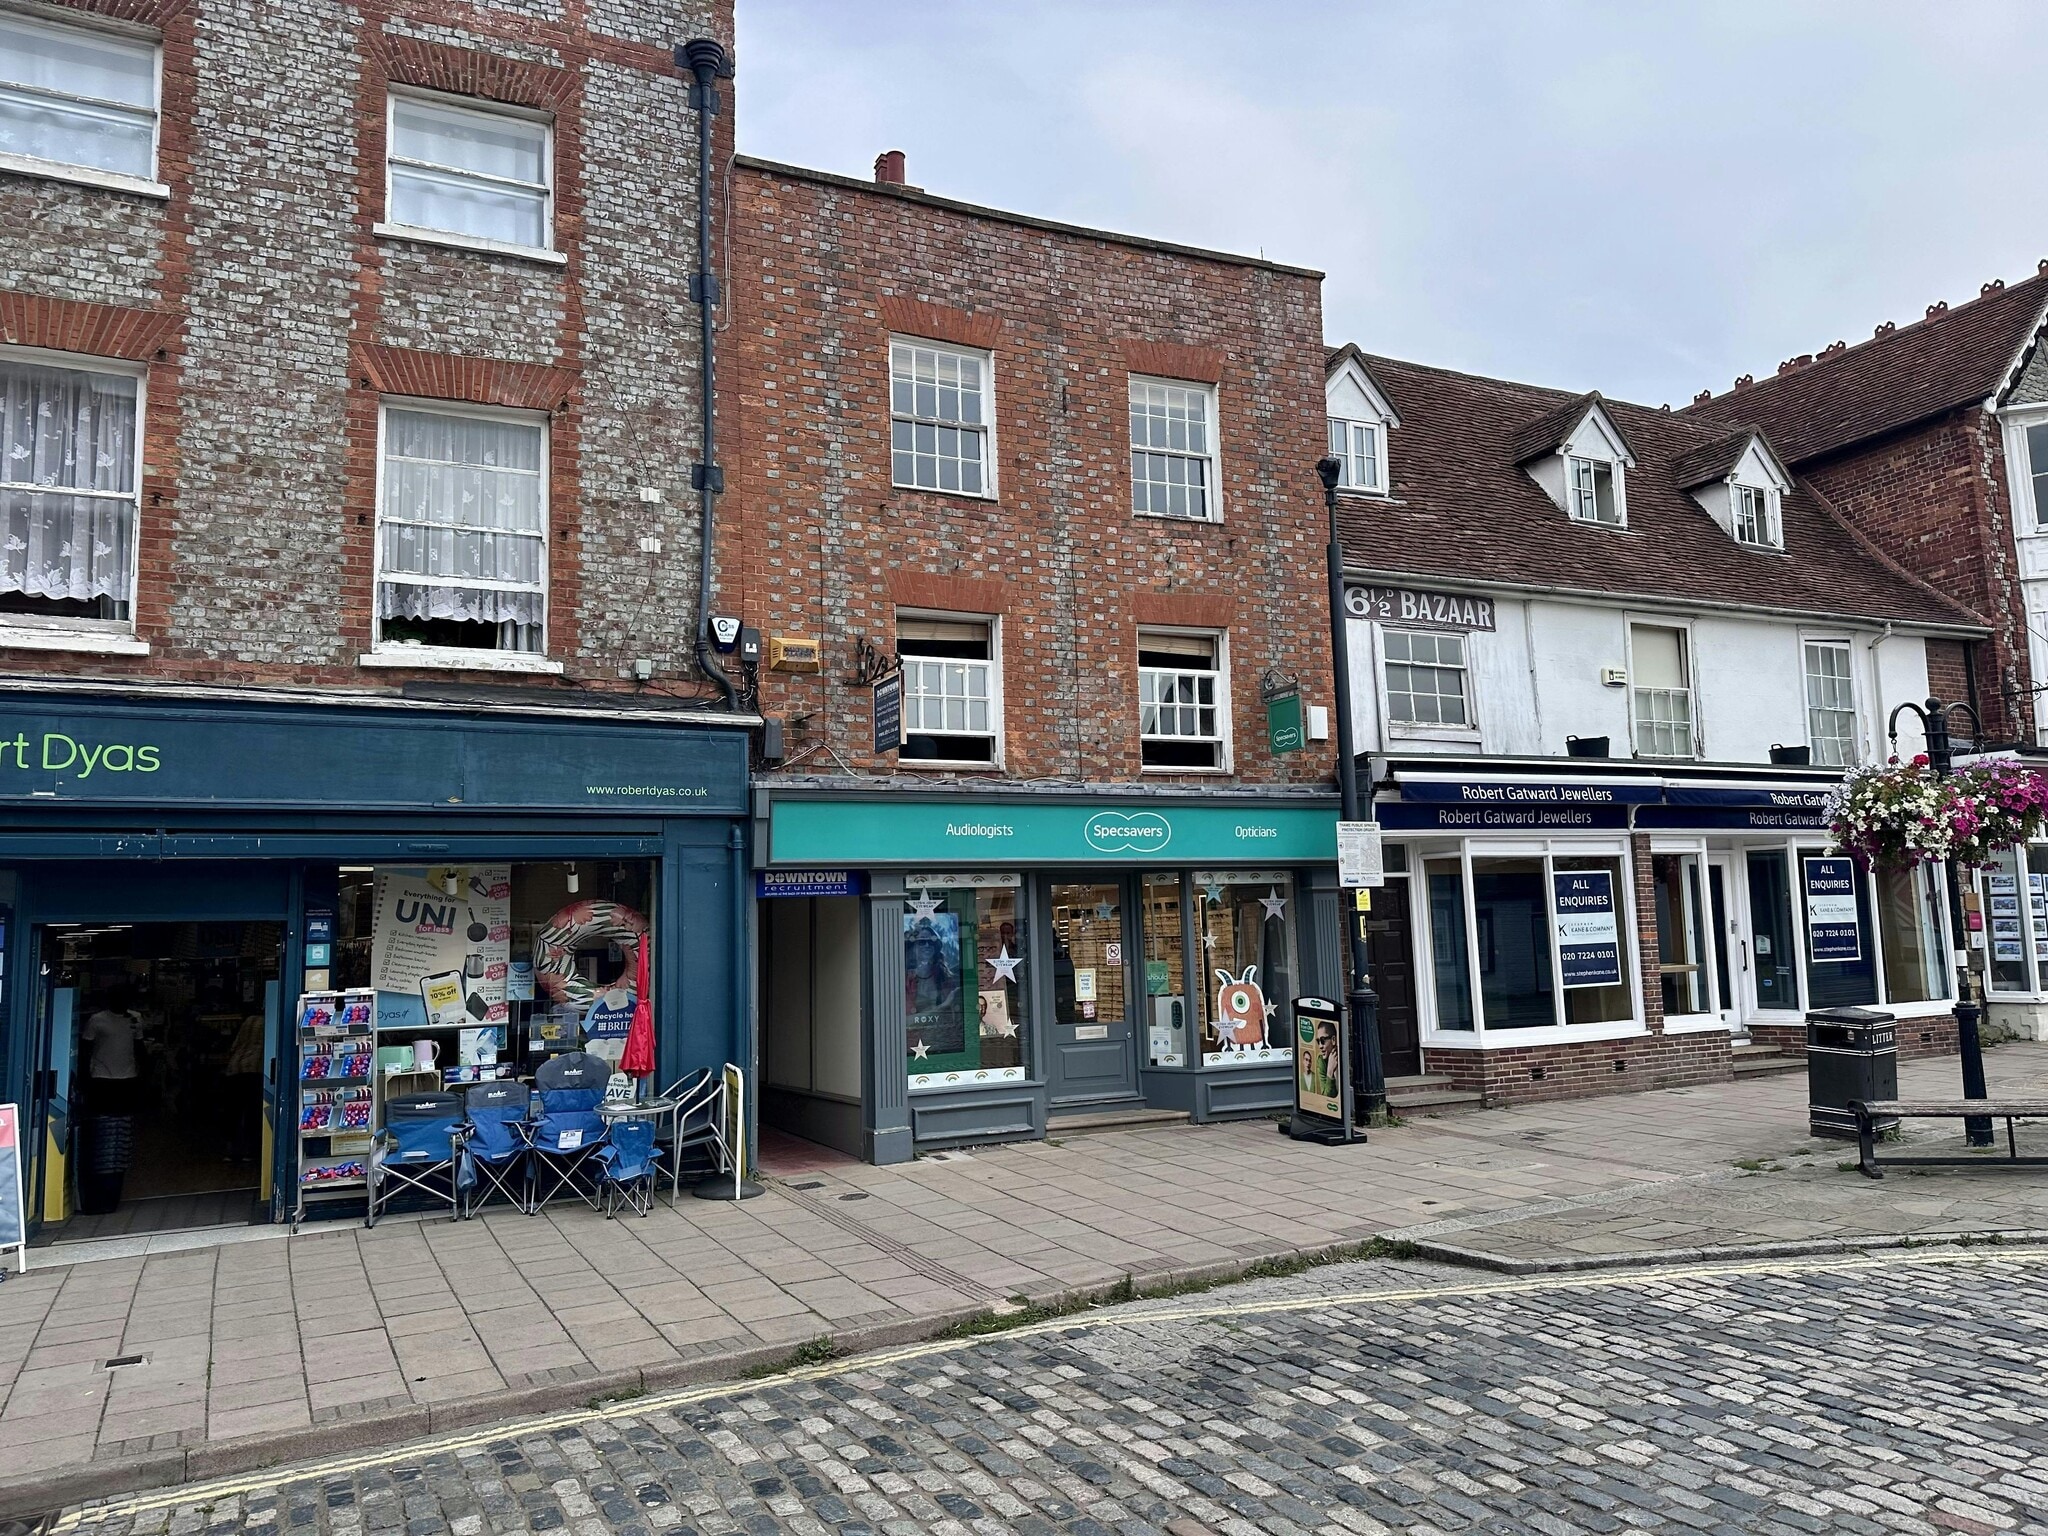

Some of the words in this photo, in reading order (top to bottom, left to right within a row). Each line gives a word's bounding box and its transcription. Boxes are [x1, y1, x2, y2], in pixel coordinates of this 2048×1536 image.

[1400, 591, 1492, 627] BAZAAR
[42, 734, 160, 778] Dyas
[586, 785, 708, 798] www.robertdyas.co.uk
[1462, 786, 1504, 800] Robert
[1507, 787, 1557, 800] Gatward
[1560, 788, 1612, 801] Jewellers
[1770, 793, 1802, 805] Robert
[1804, 794, 1828, 806] Gatw
[1439, 810, 1480, 824] Robert
[1484, 810, 1534, 824] Gatward
[1538, 810, 1592, 824] Jewellers
[1750, 812, 1782, 825] Robert
[946, 824, 1014, 838] Audiologists
[1094, 824, 1163, 839] Specsavers
[1235, 826, 1277, 840] Opticians
[1820, 865, 1834, 874] ALL
[765, 872, 846, 883] DOWNTOWN
[1572, 880, 1590, 890] ALL
[1810, 880, 1850, 890] ENQUIRIES
[403, 890, 443, 903] Everything
[1560, 895, 1608, 907] ENQUIRIES
[396, 898, 457, 929] UNI
[1810, 904, 1817, 916] K
[418, 924, 431, 932] for
[433, 926, 450, 934] less
[1558, 923, 1568, 936] K
[1562, 952, 1575, 960] 020
[1578, 952, 1595, 960] 7224
[1597, 950, 1614, 958] 0101
[430, 990, 446, 1000] 10%
[446, 988, 456, 996] off
[492, 1010, 505, 1018] OFF
[594, 1012, 624, 1020] Recycle
[914, 1016, 940, 1024] ROXY
[1872, 1032, 1893, 1044] LITTER
[607, 1088, 631, 1098] AVE
